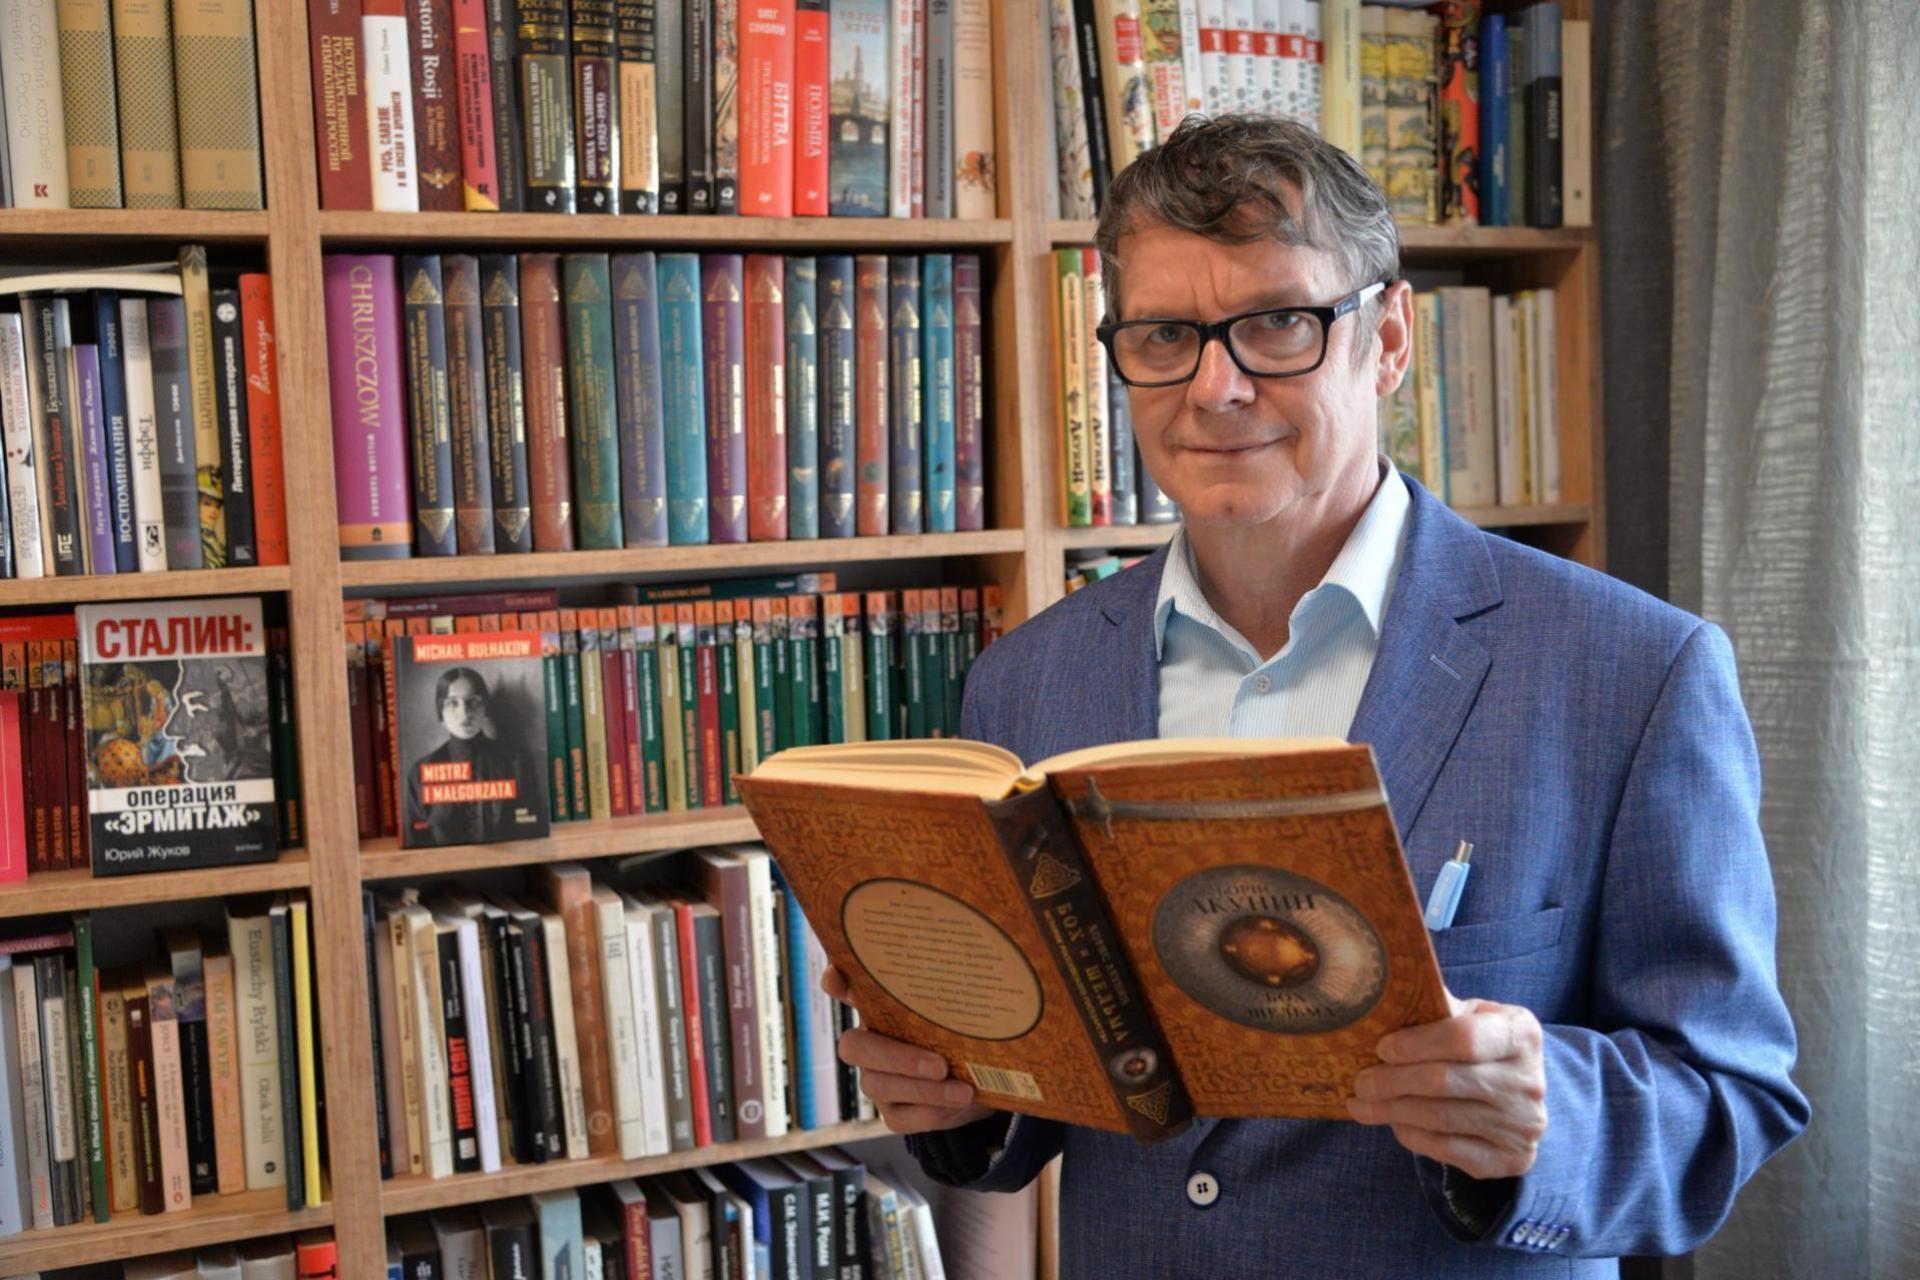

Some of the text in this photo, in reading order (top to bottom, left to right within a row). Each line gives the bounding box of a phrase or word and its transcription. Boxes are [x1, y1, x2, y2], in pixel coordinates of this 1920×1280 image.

[420, 0, 444, 100] storia Rosji
[1236, 33, 1250, 54] 2
[16, 72, 36, 138] Россию
[772, 81, 790, 147] БИТВА
[807, 83, 823, 158] ПОЛЬША
[350, 264, 381, 428] CHRUSZCZOW
[136, 414, 154, 471] Тэффи
[223, 336, 244, 493] Литературная мастерская
[112, 415, 132, 542] ВОСПОМИНАНИЯ
[95, 614, 254, 659] СТАЛИН:
[415, 640, 531, 660] MICHAIŁ BUŁHAKOW
[126, 784, 236, 810] операция
[421, 762, 471, 783] MISTRZ
[423, 782, 514, 803] I MAŁGORZATA
[104, 804, 261, 836] «ЭРМИТАЖ»
[104, 845, 191, 864] Юрий Жуков
[1192, 894, 1316, 915] АКУНИН
[248, 929, 269, 1055] Eustachy Rylski
[1054, 901, 1131, 1044] БОХ ШЕЛЬМА
[258, 1078, 274, 1144] Obok Julii
[448, 1037, 474, 1130] ІНШИЙ СВІТ
[783, 1193, 796, 1220] С.М.
[816, 1193, 831, 1267] М.И. Ромм
